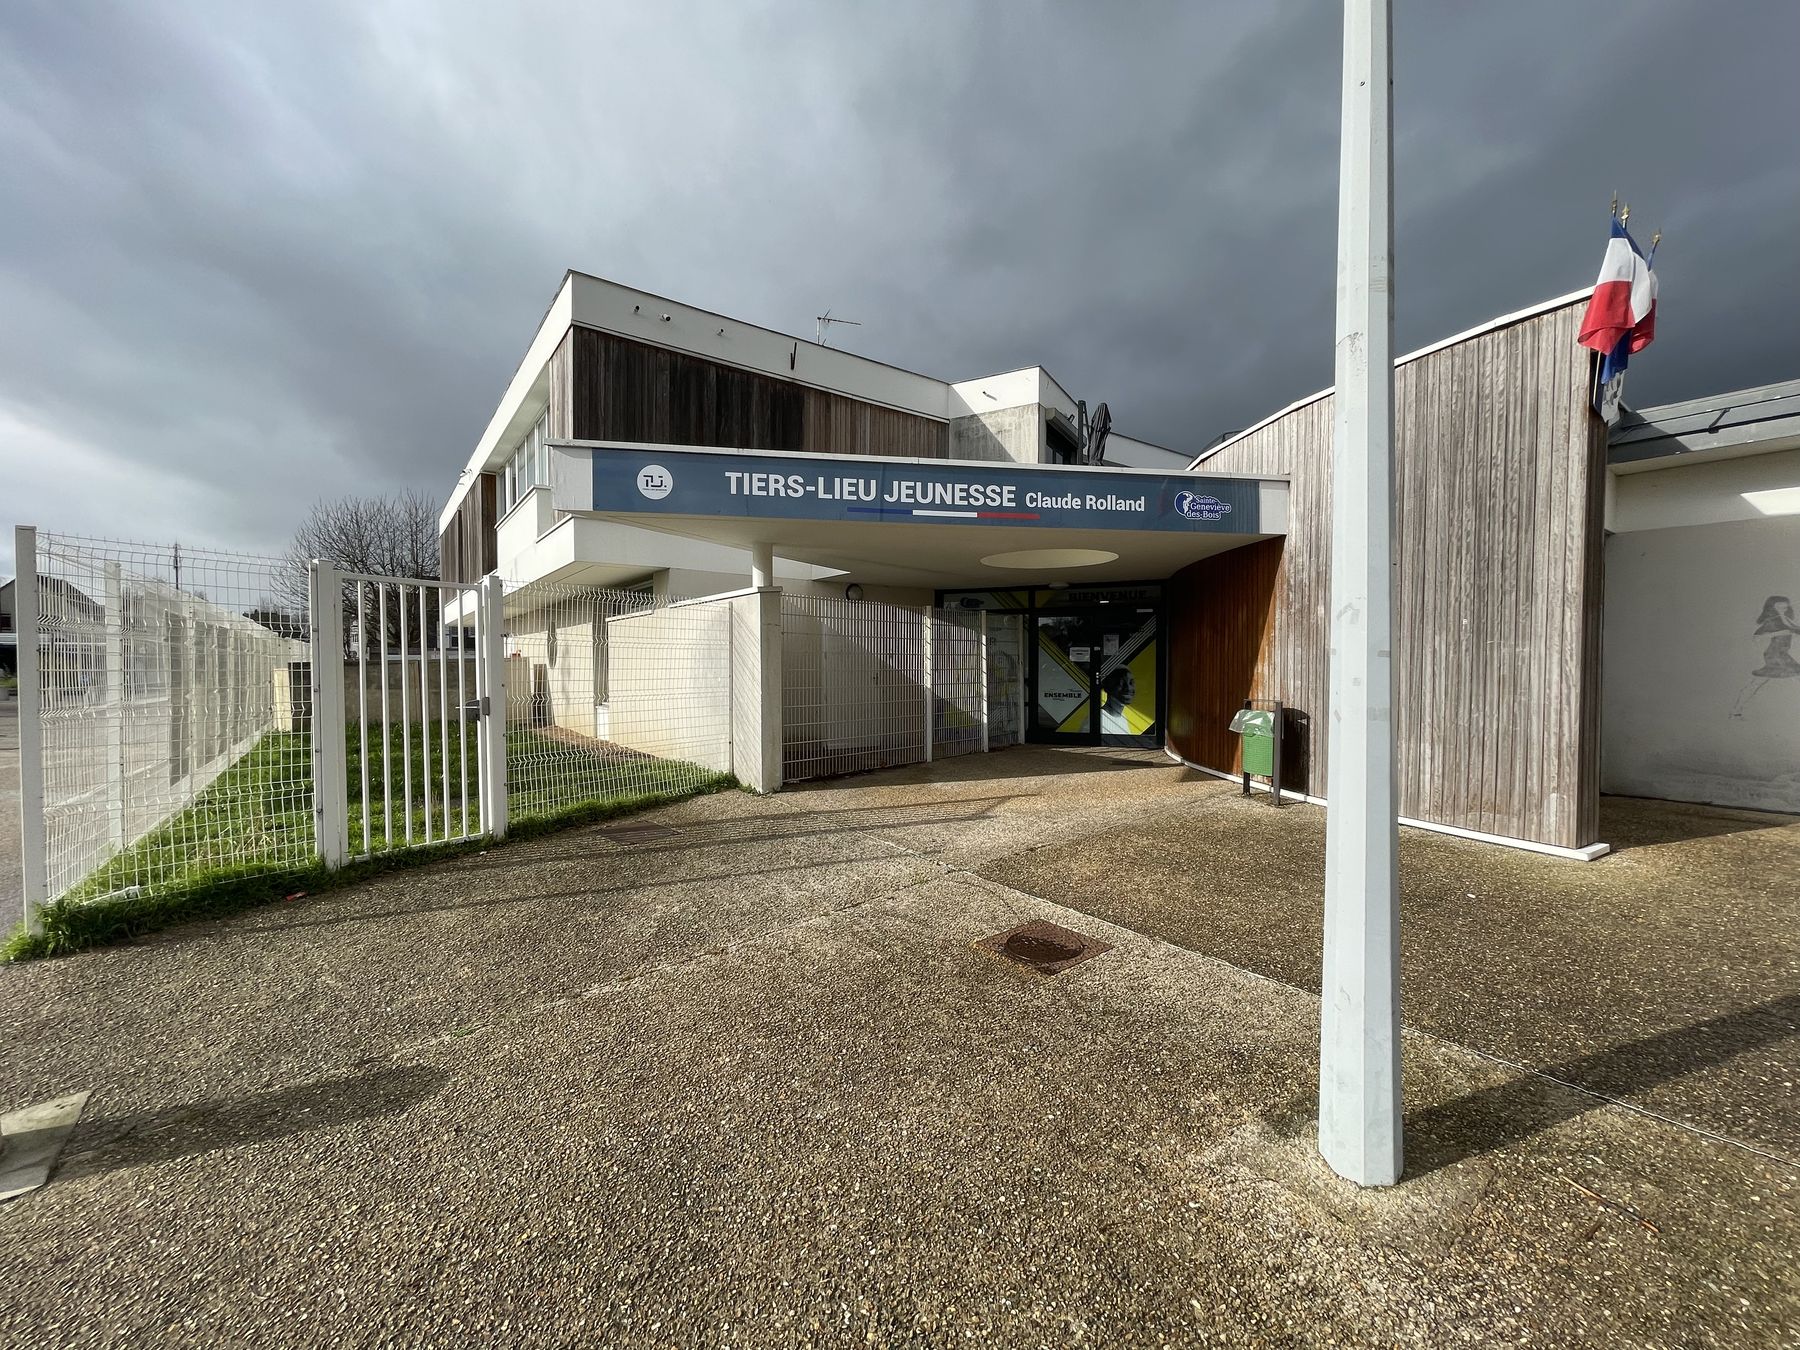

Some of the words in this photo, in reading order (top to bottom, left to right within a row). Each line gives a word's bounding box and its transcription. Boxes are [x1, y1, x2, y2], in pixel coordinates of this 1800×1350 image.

[724, 471, 877, 502] TIERS-LIEU
[883, 480, 1017, 507] JEUNESSE
[1025, 492, 1081, 509] Claude
[1086, 495, 1145, 512] Rolland
